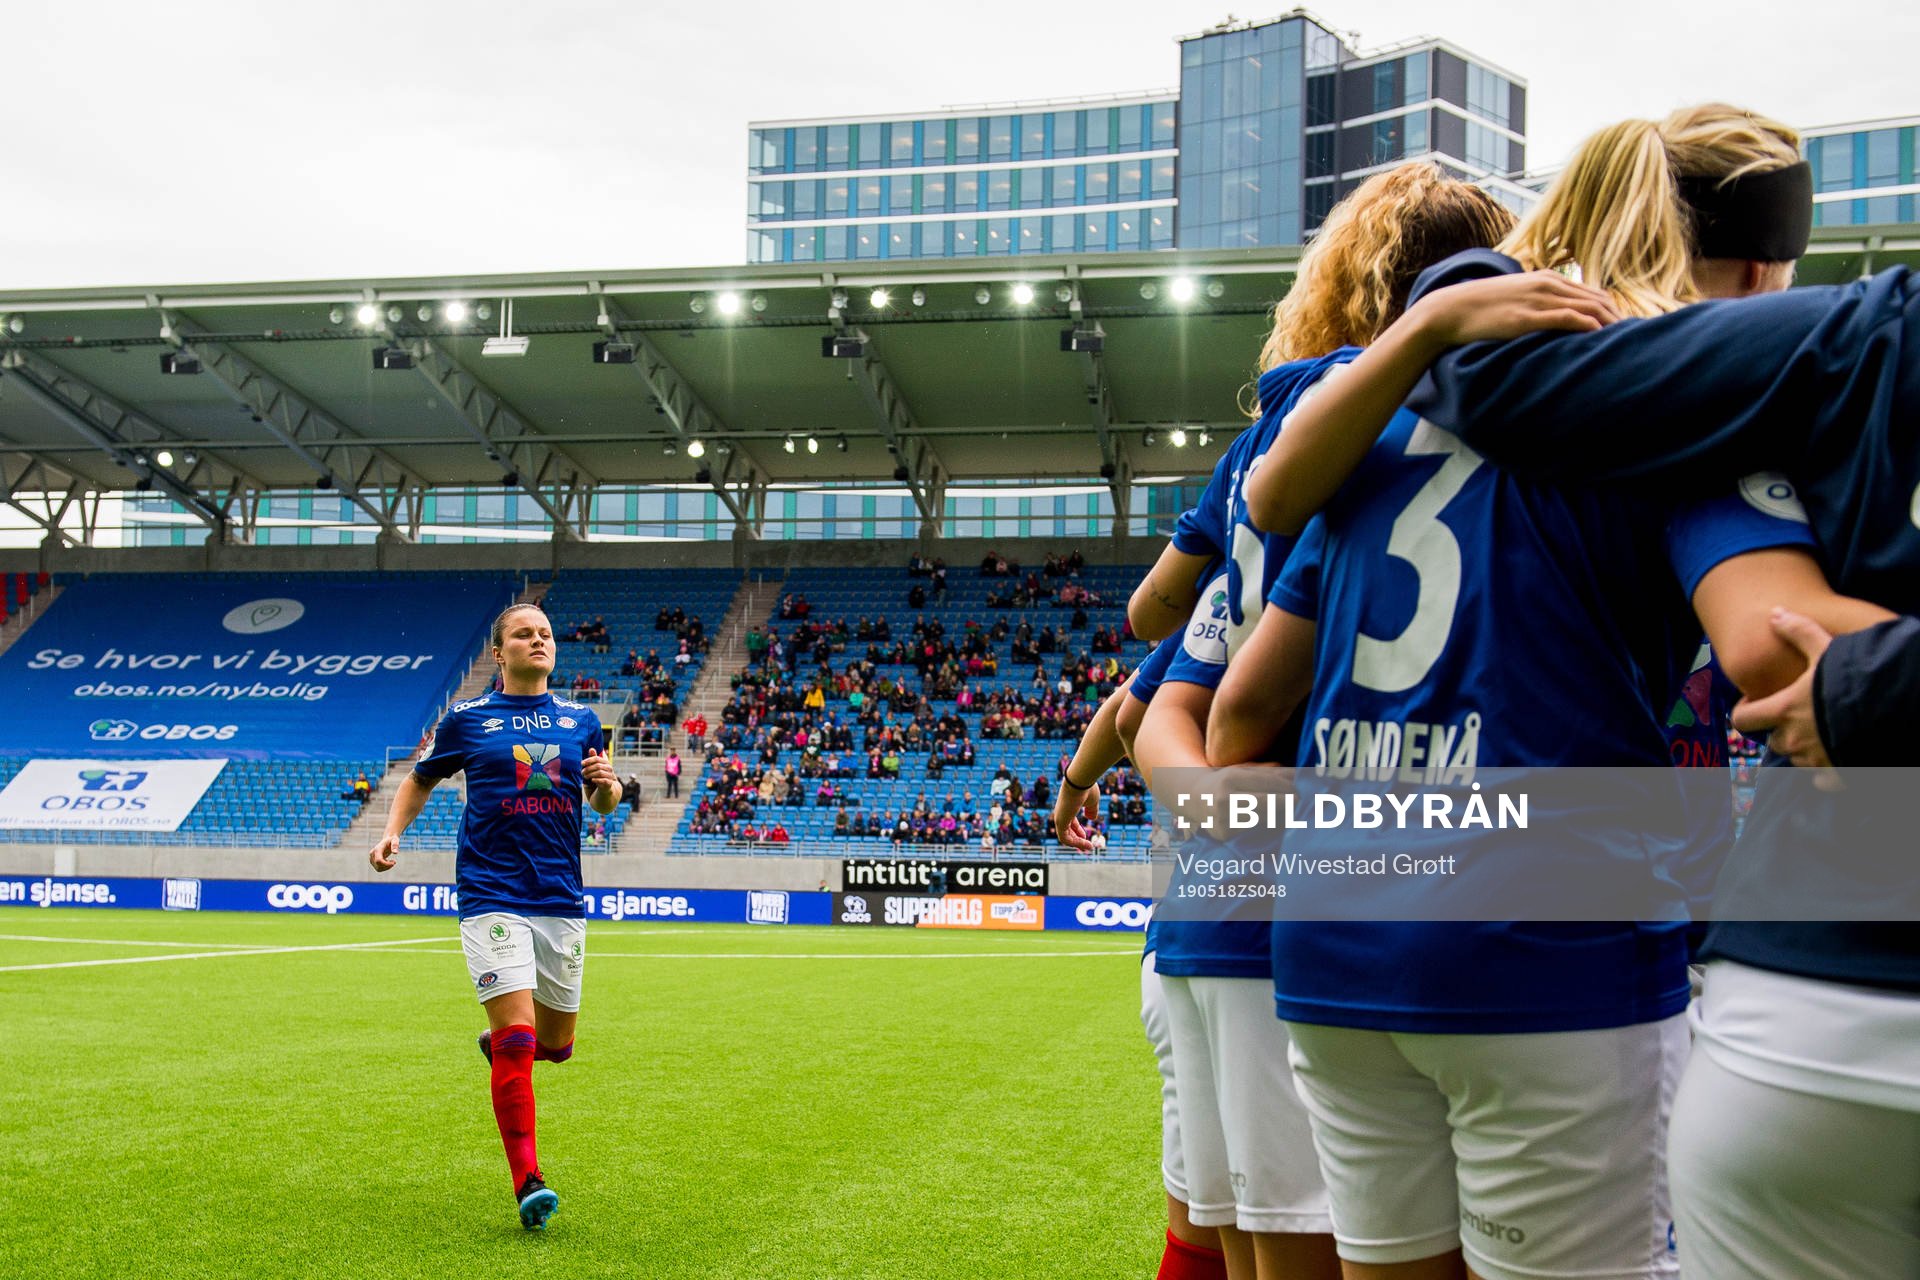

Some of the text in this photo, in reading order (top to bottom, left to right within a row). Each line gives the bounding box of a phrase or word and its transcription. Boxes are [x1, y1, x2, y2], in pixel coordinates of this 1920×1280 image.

[1352, 416, 1485, 692] 3
[1193, 622, 1227, 643] OBO
[28, 648, 433, 675] Se hvor vi bygger
[74, 681, 328, 700] obos.no/nybolig
[140, 724, 239, 740] OBOS
[512, 712, 552, 733] DNB
[1315, 711, 1481, 786] SØNDENÅ
[1670, 738, 1721, 769] ONA
[41, 795, 150, 811] OBOS
[502, 795, 573, 816] SABONA
[847, 859, 1044, 887] intilit arena
[31, 878, 116, 908] sjanse.
[267, 884, 354, 914] coop
[404, 885, 428, 910] Gi
[583, 895, 595, 914] n
[602, 890, 695, 920] sjanse.
[884, 897, 983, 925] SUPERHELG
